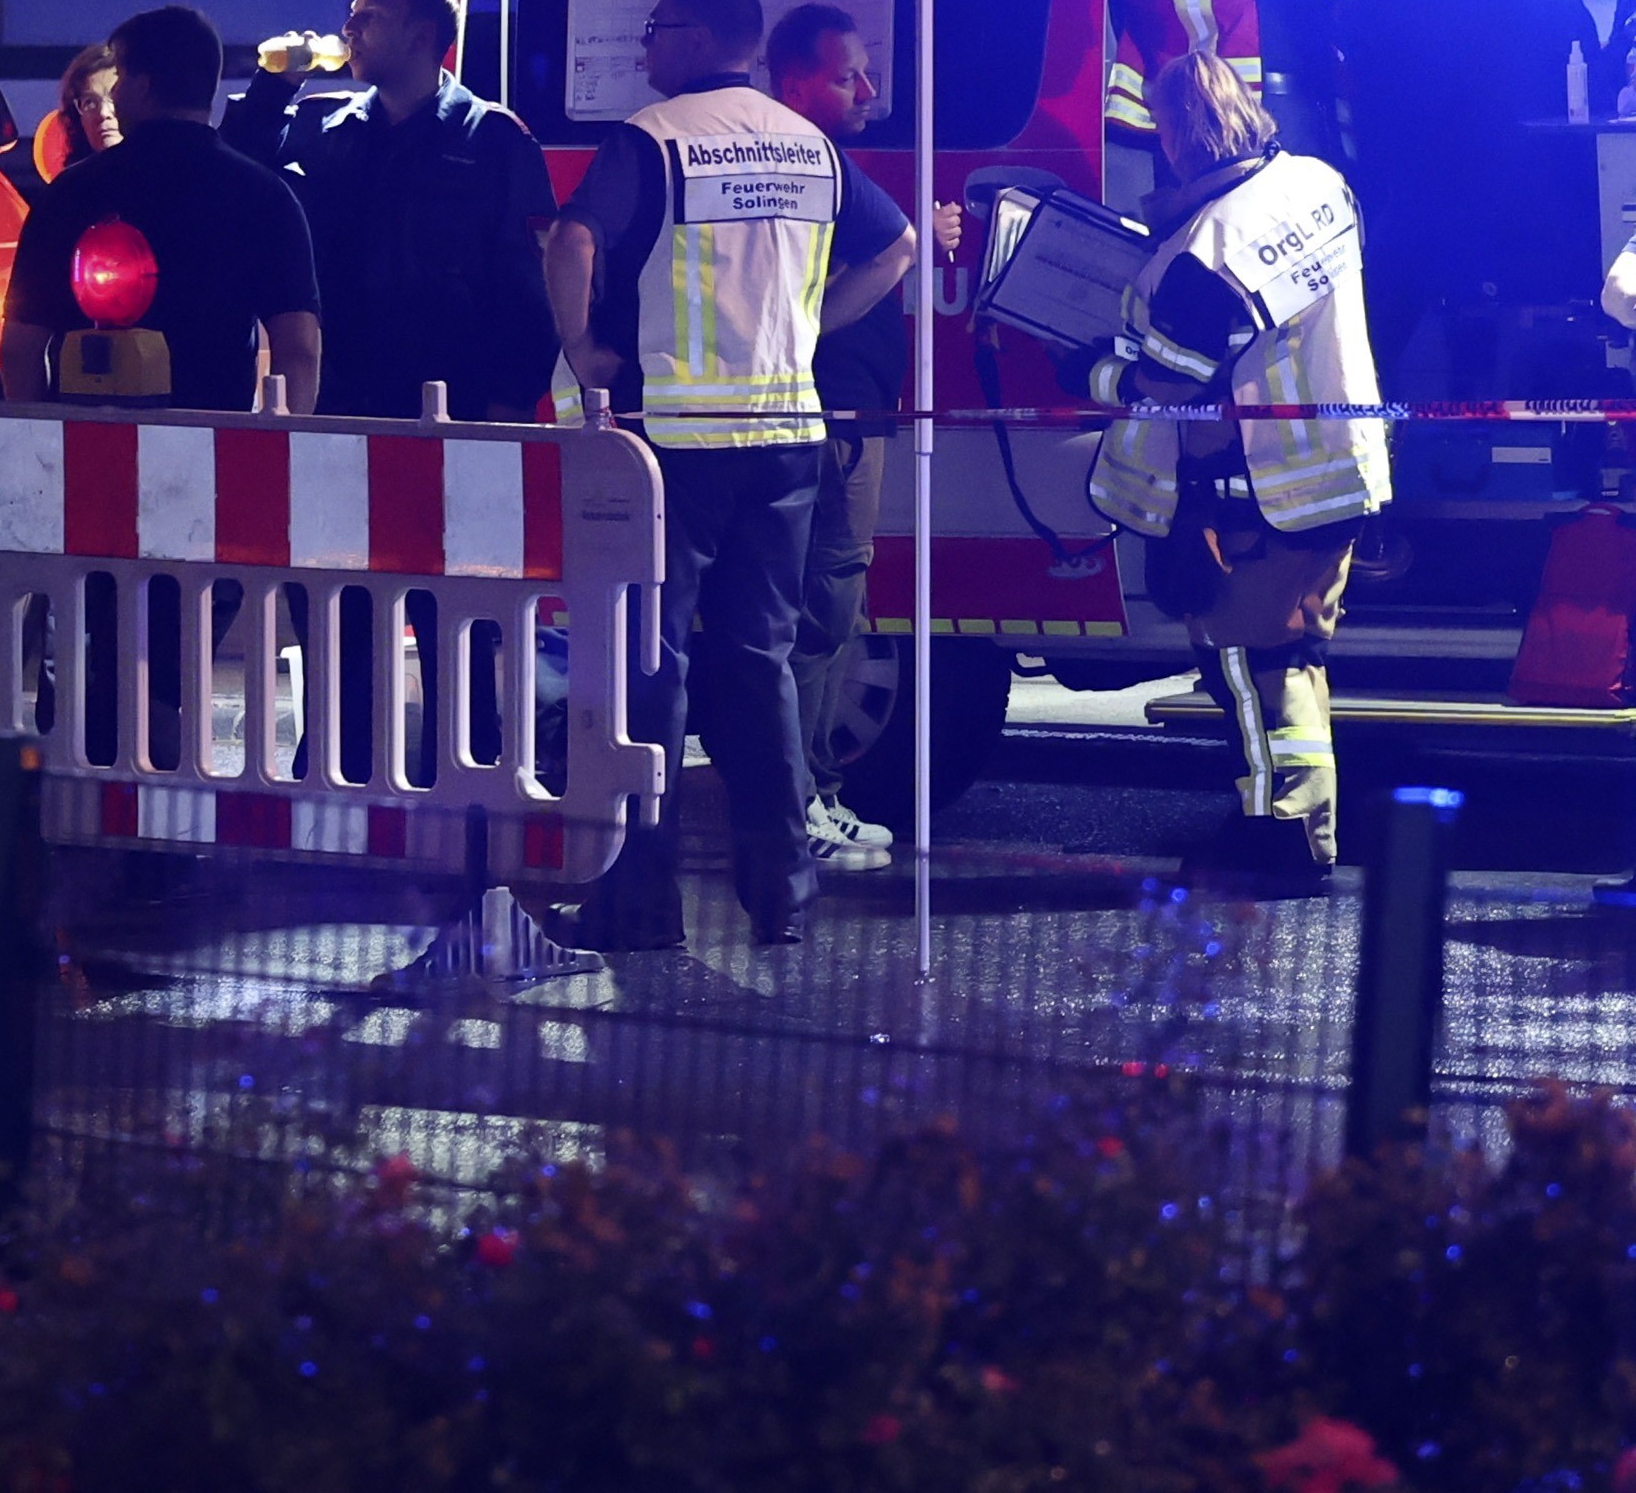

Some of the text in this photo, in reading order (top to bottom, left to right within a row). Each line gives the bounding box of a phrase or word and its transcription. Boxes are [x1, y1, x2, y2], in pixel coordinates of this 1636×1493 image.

[687, 140, 822, 167] Abschnittsleiter
[721, 180, 805, 196] Feuerwehr
[732, 195, 798, 210] Solingen
